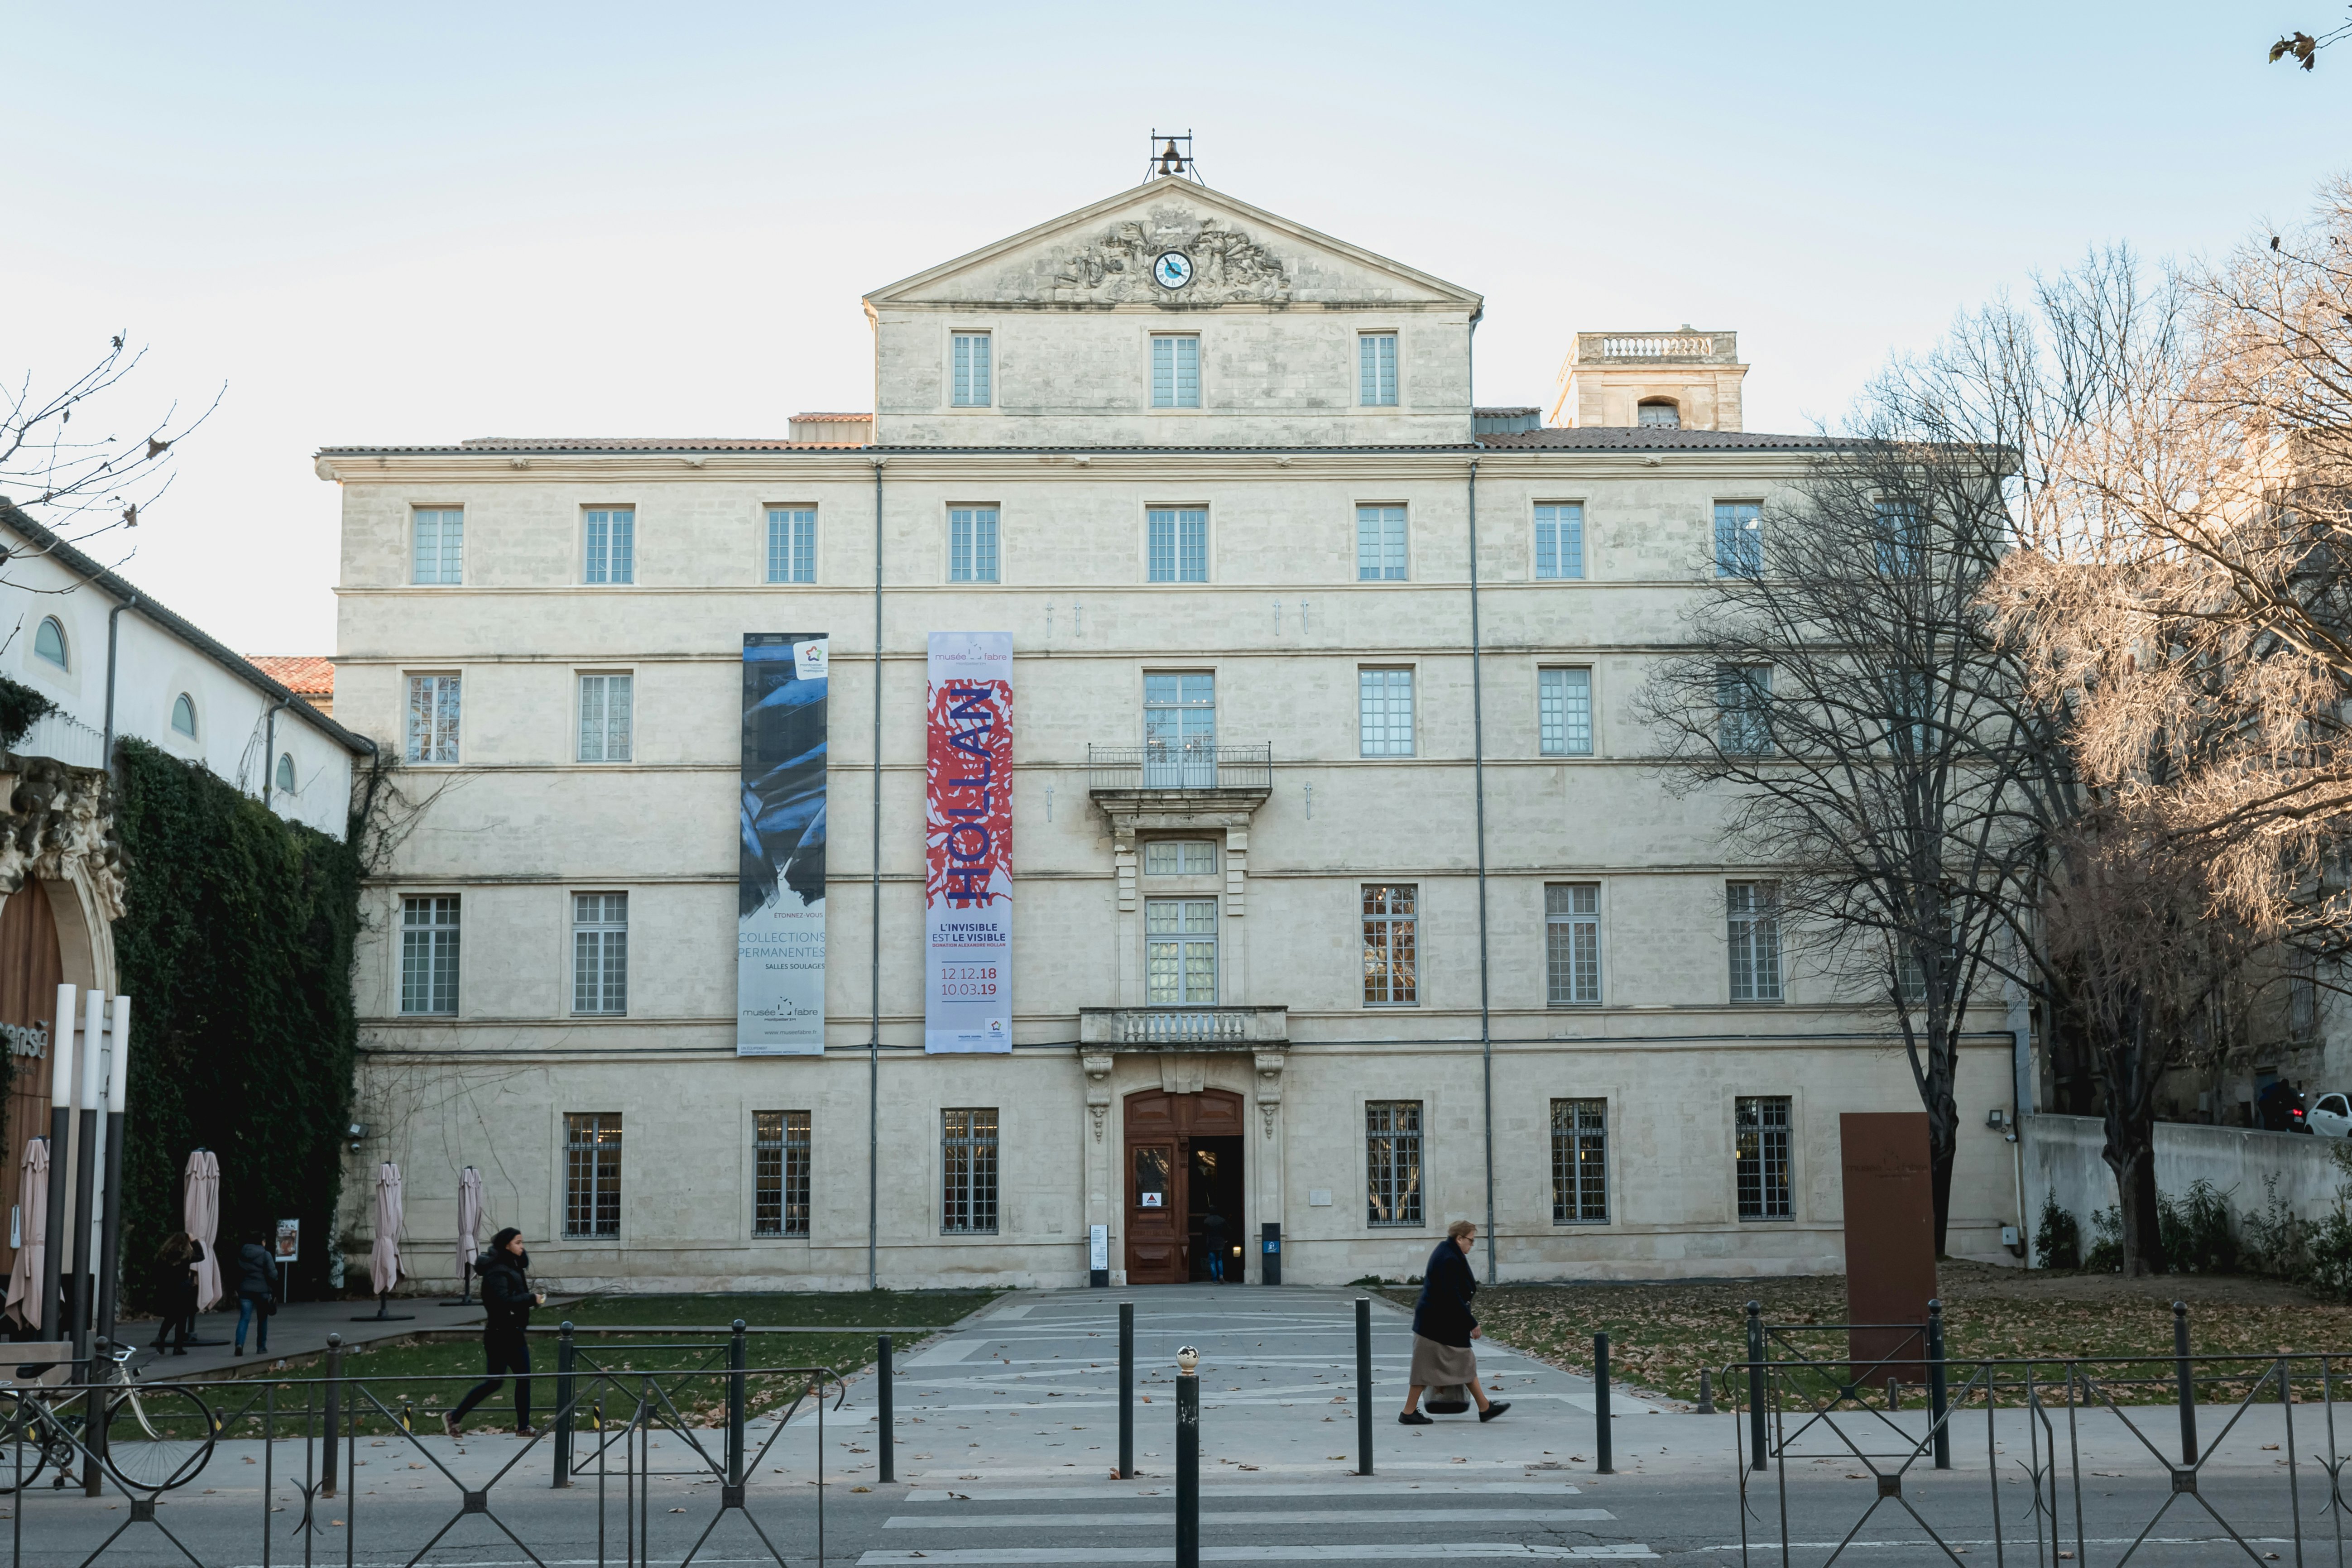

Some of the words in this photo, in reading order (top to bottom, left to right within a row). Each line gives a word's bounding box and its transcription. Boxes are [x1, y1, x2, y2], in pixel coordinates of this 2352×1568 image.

[947, 689, 992, 900] HOLLAN
[941, 923, 998, 931] L'INVISIBLE
[738, 932, 826, 943] COLLECTIONS
[932, 934, 950, 942] EST
[967, 933, 1006, 941] VISIBLE
[738, 947, 826, 958] PERMANENTES
[942, 968, 997, 979] 12.12.18
[942, 983, 997, 995] 10.03.19
